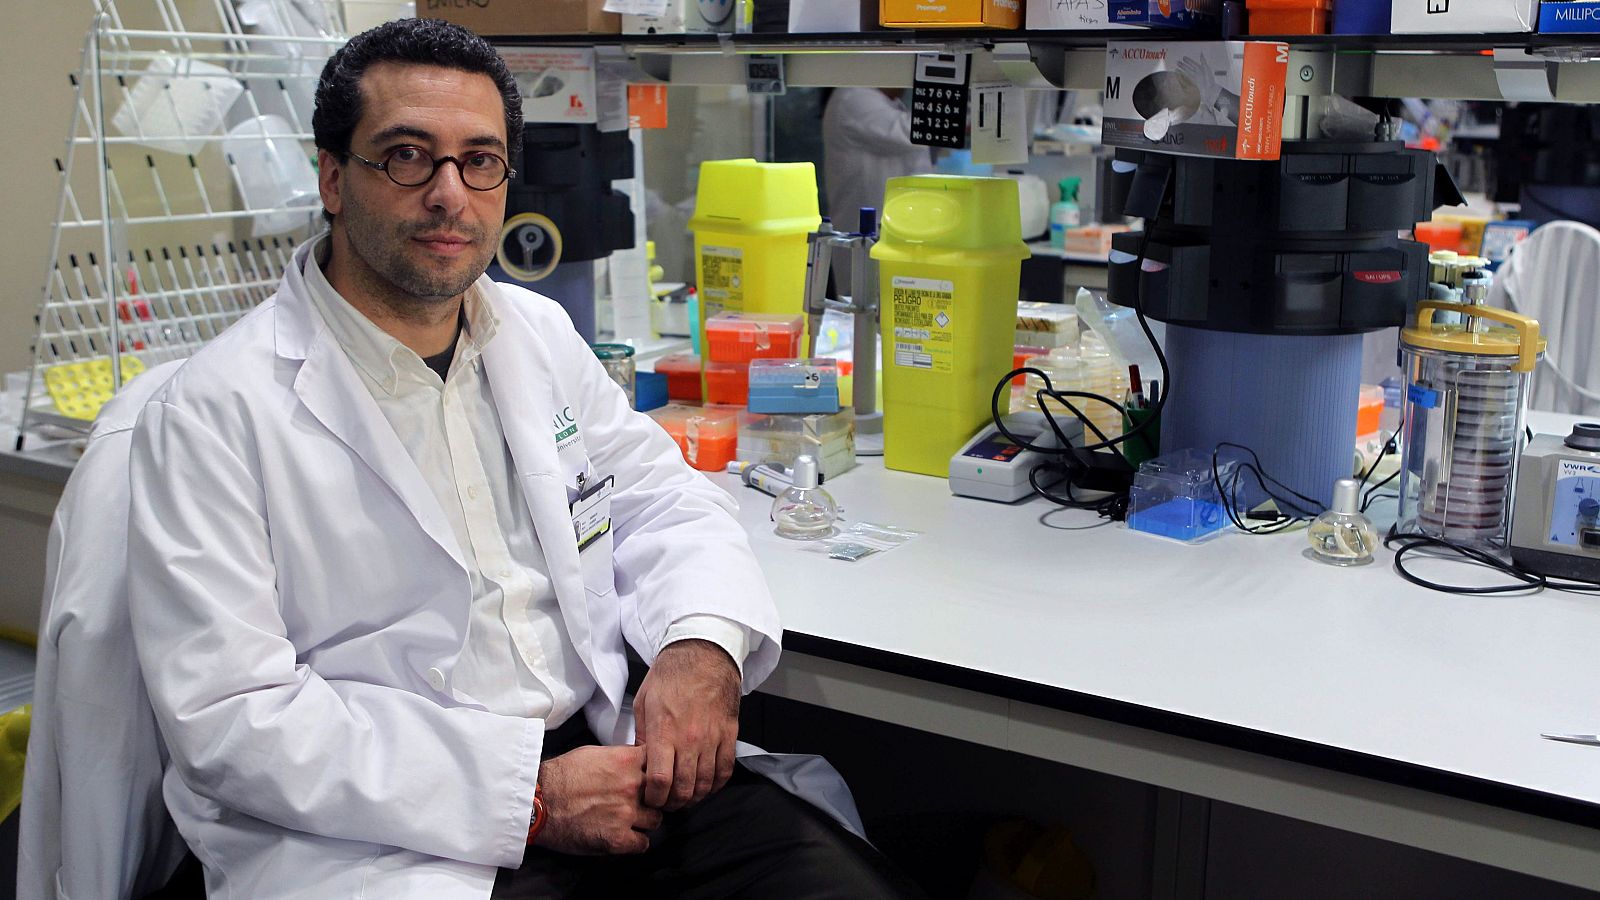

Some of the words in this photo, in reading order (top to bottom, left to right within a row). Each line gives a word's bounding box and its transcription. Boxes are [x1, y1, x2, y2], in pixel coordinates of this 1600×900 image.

[1121, 48, 1167, 60] ACCUtouch
[1276, 45, 1289, 63] M
[928, 88, 934, 98] 7
[945, 89, 952, 99] 9
[1105, 76, 1121, 99] M
[927, 102, 933, 112] 4
[935, 103, 942, 113] 5
[944, 104, 951, 114] 6
[1244, 77, 1256, 133] ACCUtouch
[935, 118, 941, 128] 2
[943, 119, 950, 129] 3
[1563, 463, 1587, 471] VWR
